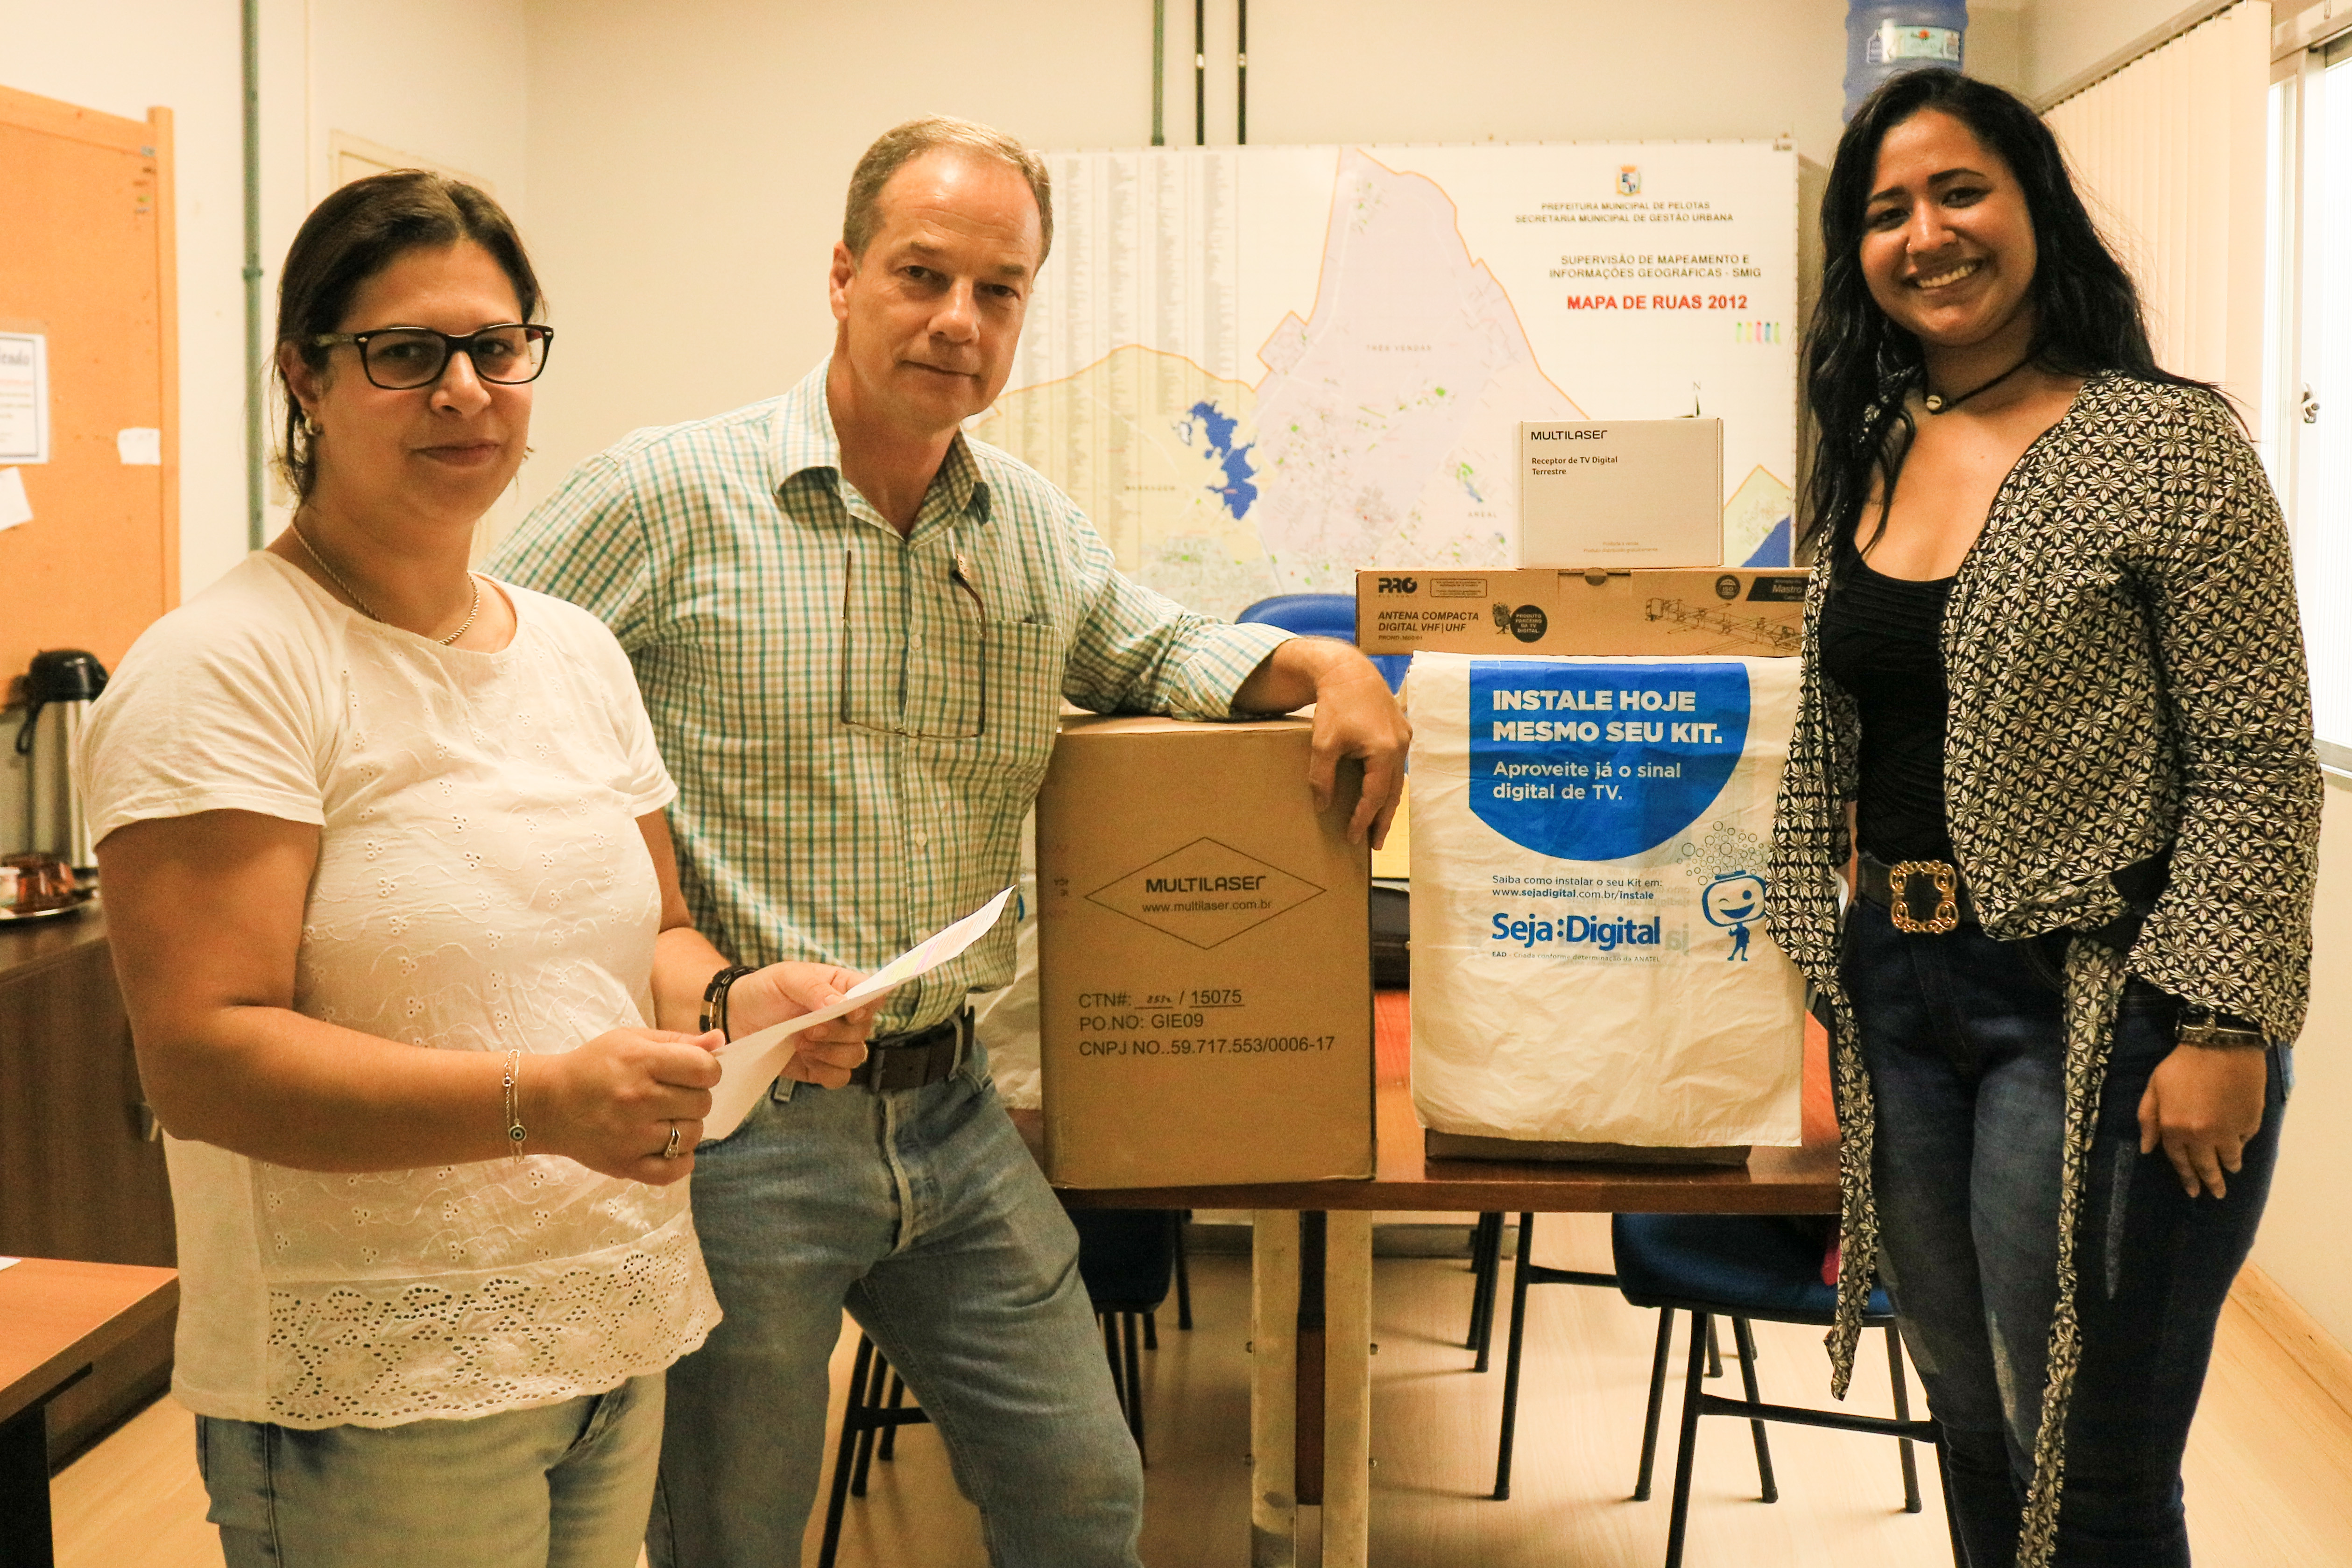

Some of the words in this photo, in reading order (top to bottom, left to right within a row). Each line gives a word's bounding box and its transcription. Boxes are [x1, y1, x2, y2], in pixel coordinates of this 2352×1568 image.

[1668, 201, 1710, 210] PELOTAS
[1515, 214, 1576, 223] SECRETARIA
[1633, 214, 1646, 222] DE
[1649, 213, 1690, 222] GESTÃO
[1561, 254, 1635, 265] SUPERVISÃO
[1639, 255, 1653, 264] DE
[1658, 254, 1739, 264] MAPEAMENTO
[1743, 255, 1749, 264] E
[1549, 267, 1634, 280] INFORMAÇÕES
[1638, 268, 1722, 278] GEOGRÁFICAS
[1733, 268, 1761, 277] SMIG
[1567, 296, 1618, 310] MAPA
[1623, 295, 1646, 310] DE
[1653, 295, 1702, 310] RUAS
[1708, 295, 1747, 309] 2012
[1532, 457, 1566, 466] Receptor
[1592, 456, 1617, 466] Digital
[1772, 585, 1802, 593] Mastro
[1377, 611, 1419, 620] ANTENA
[1421, 611, 1479, 621] COMPACTA
[1378, 622, 1418, 631] DIGITAL
[1493, 690, 1613, 711] INSTALE
[1619, 690, 1696, 712] HOJE
[1493, 720, 1600, 742] MESMO
[1605, 721, 1664, 743] SEU
[1671, 722, 1723, 744] KIT.
[1493, 761, 1589, 779] Aproveite
[1595, 761, 1612, 779] já
[1618, 765, 1632, 777] o
[1637, 762, 1681, 778] sinal
[1493, 783, 1554, 802] digital
[1561, 784, 1585, 800] de
[1592, 784, 1623, 800] TV.
[1492, 875, 1520, 884] Saiba
[1555, 876, 1594, 886] instalar
[1627, 878, 1642, 888] Kit
[1492, 888, 1655, 901] www.sejadigital.com.br/instale
[1141, 898, 1272, 913] www.multilaser.com.br
[1078, 992, 1132, 1009] CTN#:
[1190, 989, 1242, 1004] 15075
[1079, 1014, 1144, 1031] PO.NO:
[1151, 1013, 1204, 1029] GIE09
[1079, 1041, 1127, 1056] CNPJ
